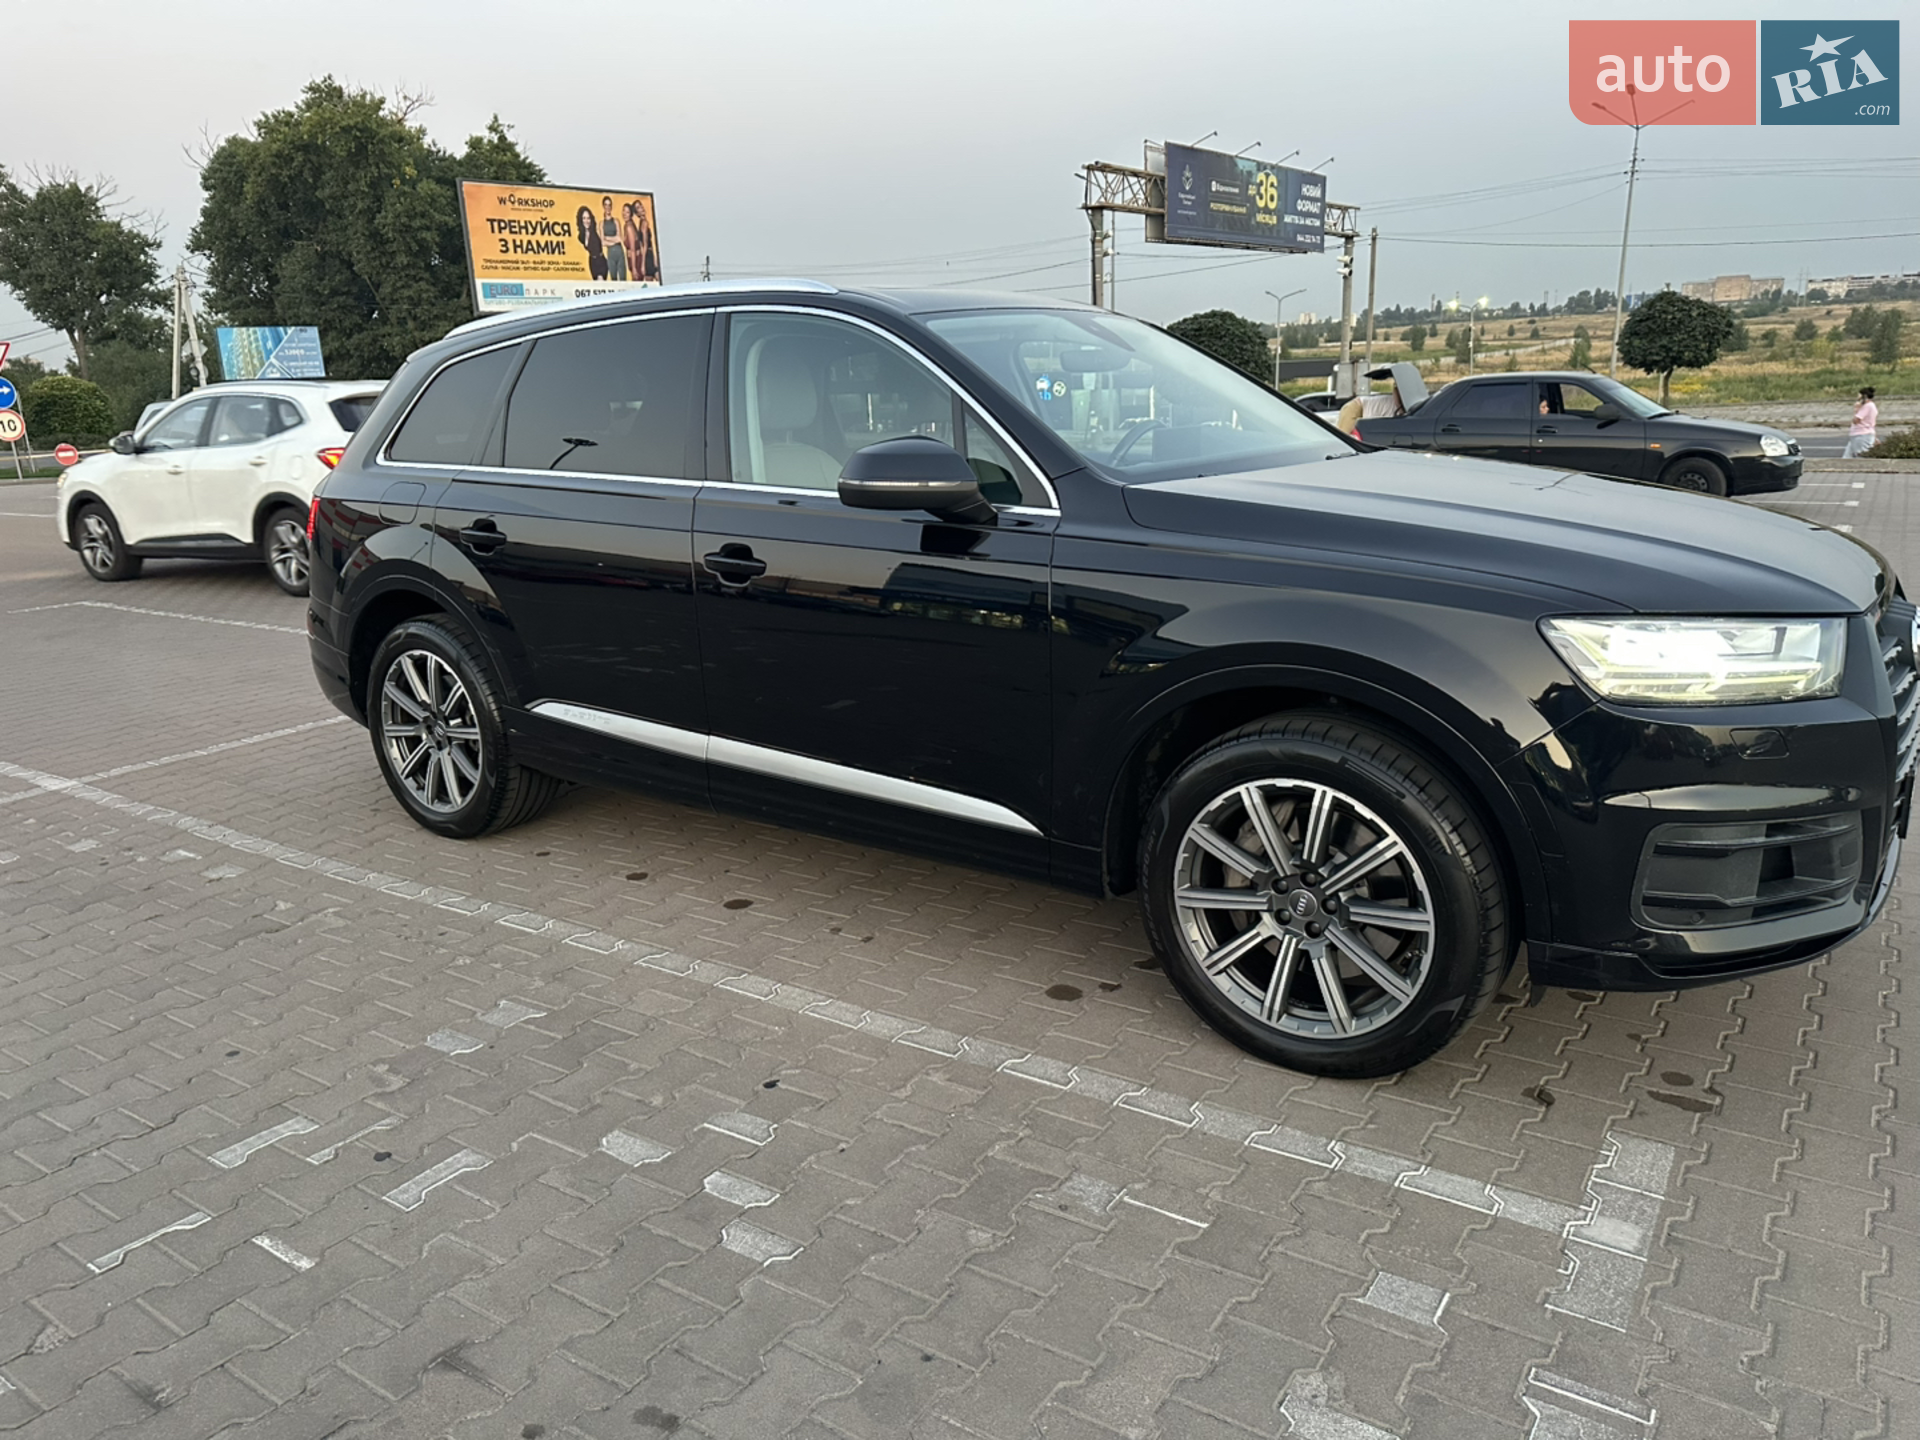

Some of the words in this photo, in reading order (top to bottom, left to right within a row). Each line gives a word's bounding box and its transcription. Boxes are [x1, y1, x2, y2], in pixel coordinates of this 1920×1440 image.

[1256, 172, 1278, 210] 36
[497, 193, 555, 209] WORKSHOP
[1296, 200, 1322, 215] ФОРМАТ
[486, 217, 572, 238] ТРЕНУЙСЯ
[513, 239, 566, 256] НАМИ!
[0, 419, 17, 433] 10
